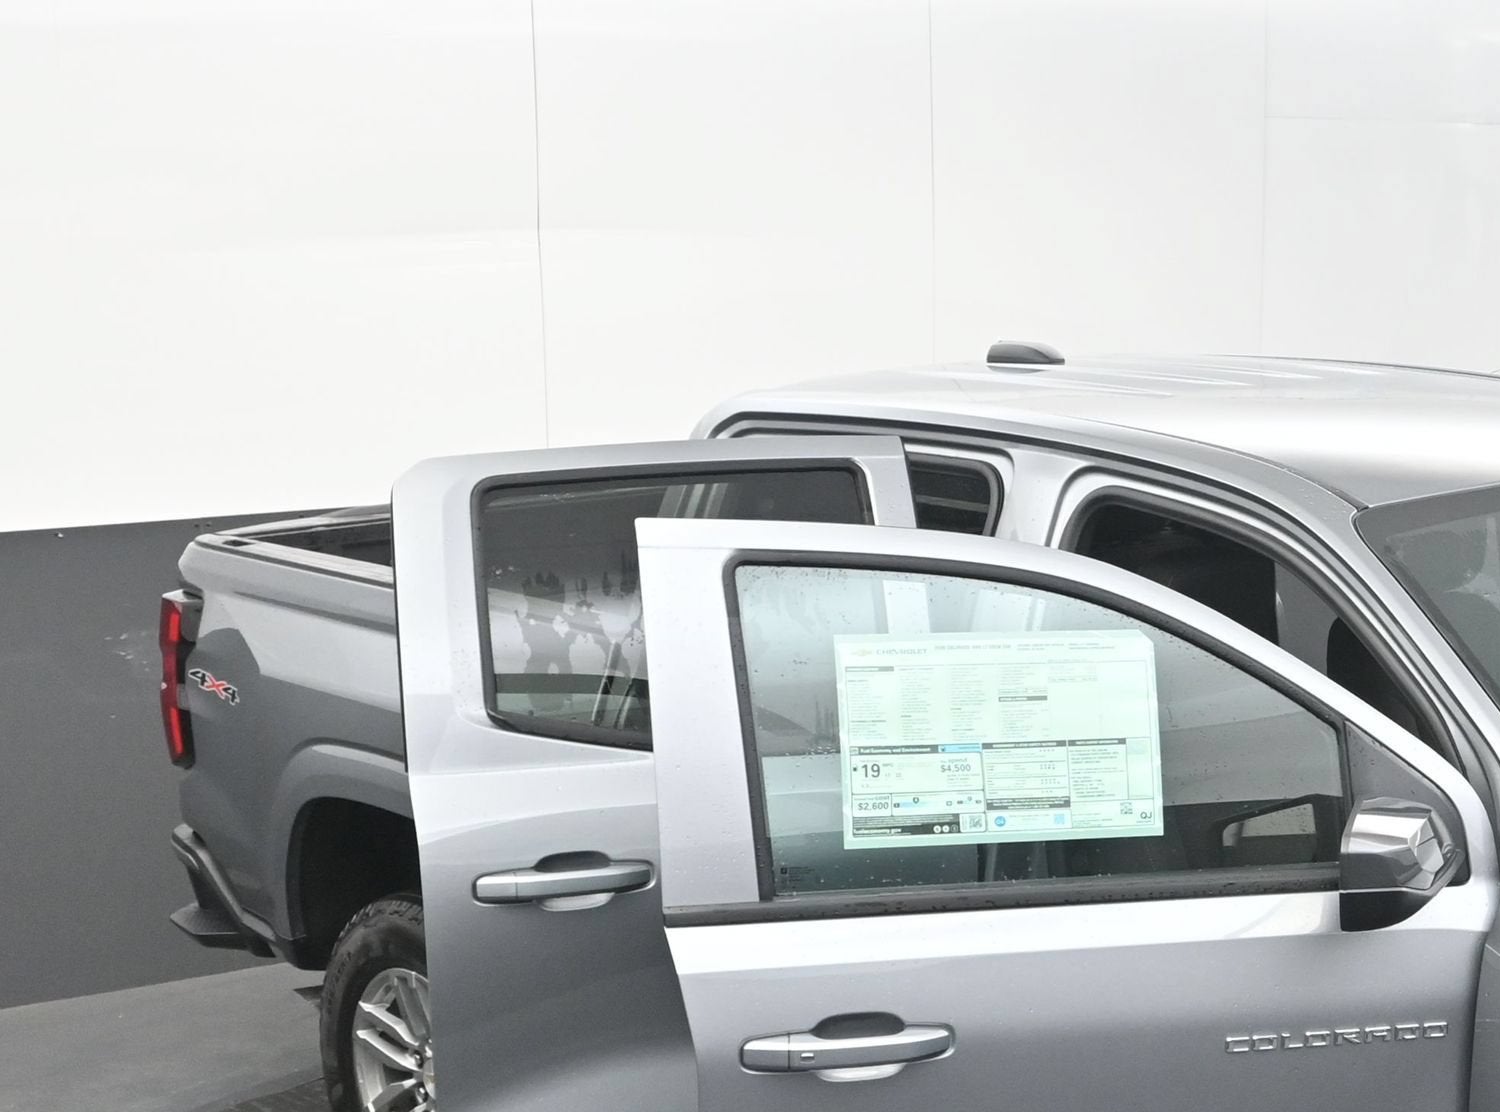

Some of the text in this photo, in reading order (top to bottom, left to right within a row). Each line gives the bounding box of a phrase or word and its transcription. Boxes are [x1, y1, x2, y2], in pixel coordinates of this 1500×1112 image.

[861, 763, 881, 778] 19
[940, 764, 972, 773] $4,500
[857, 801, 889, 811] $2,600
[1225, 1021, 1448, 1054] COLORADO
